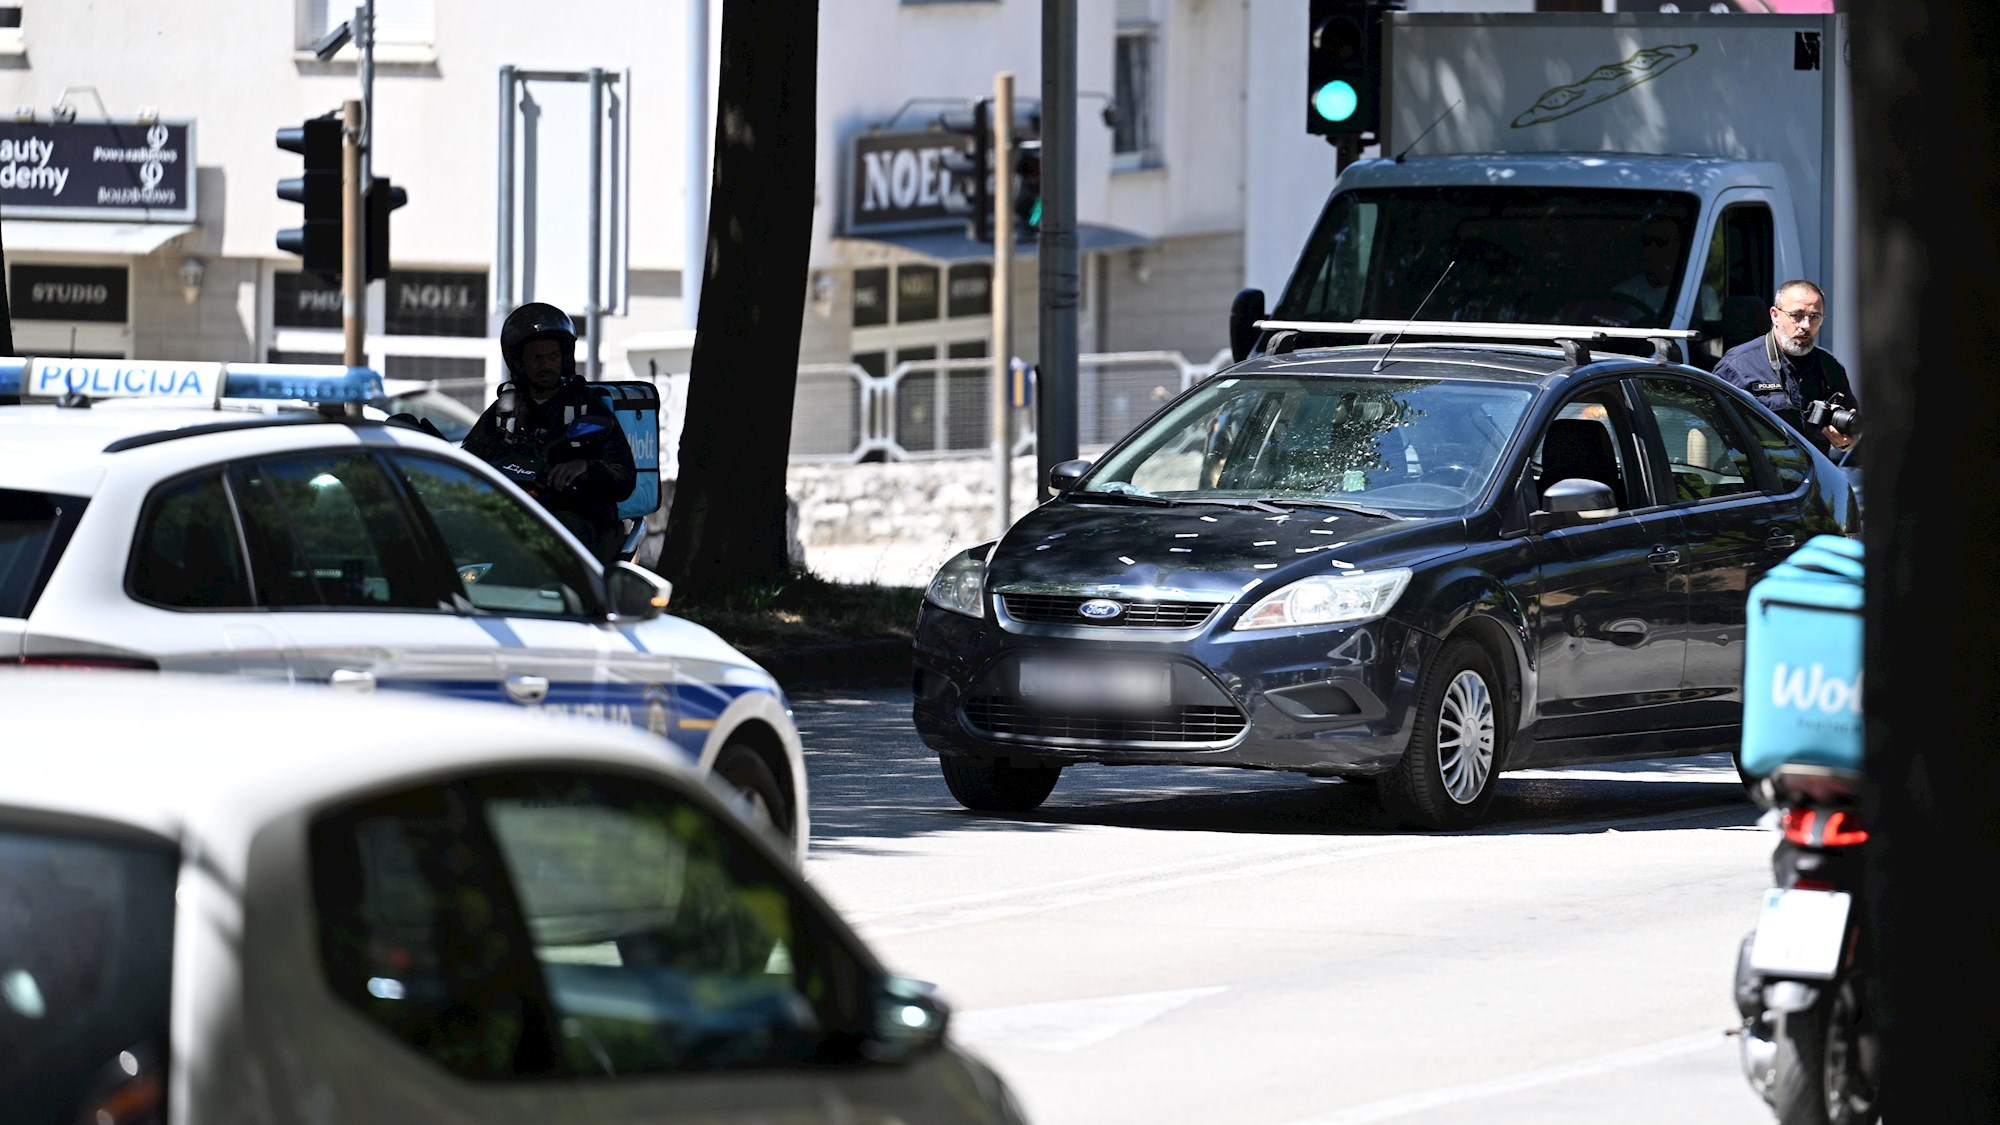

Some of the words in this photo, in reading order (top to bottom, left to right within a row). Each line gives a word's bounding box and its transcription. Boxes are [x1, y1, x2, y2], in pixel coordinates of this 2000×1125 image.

[32, 282, 107, 304] STUDIO
[40, 365, 203, 394] POLICIJA
[628, 430, 654, 460] Wolt
[1771, 661, 1863, 716] Wol
